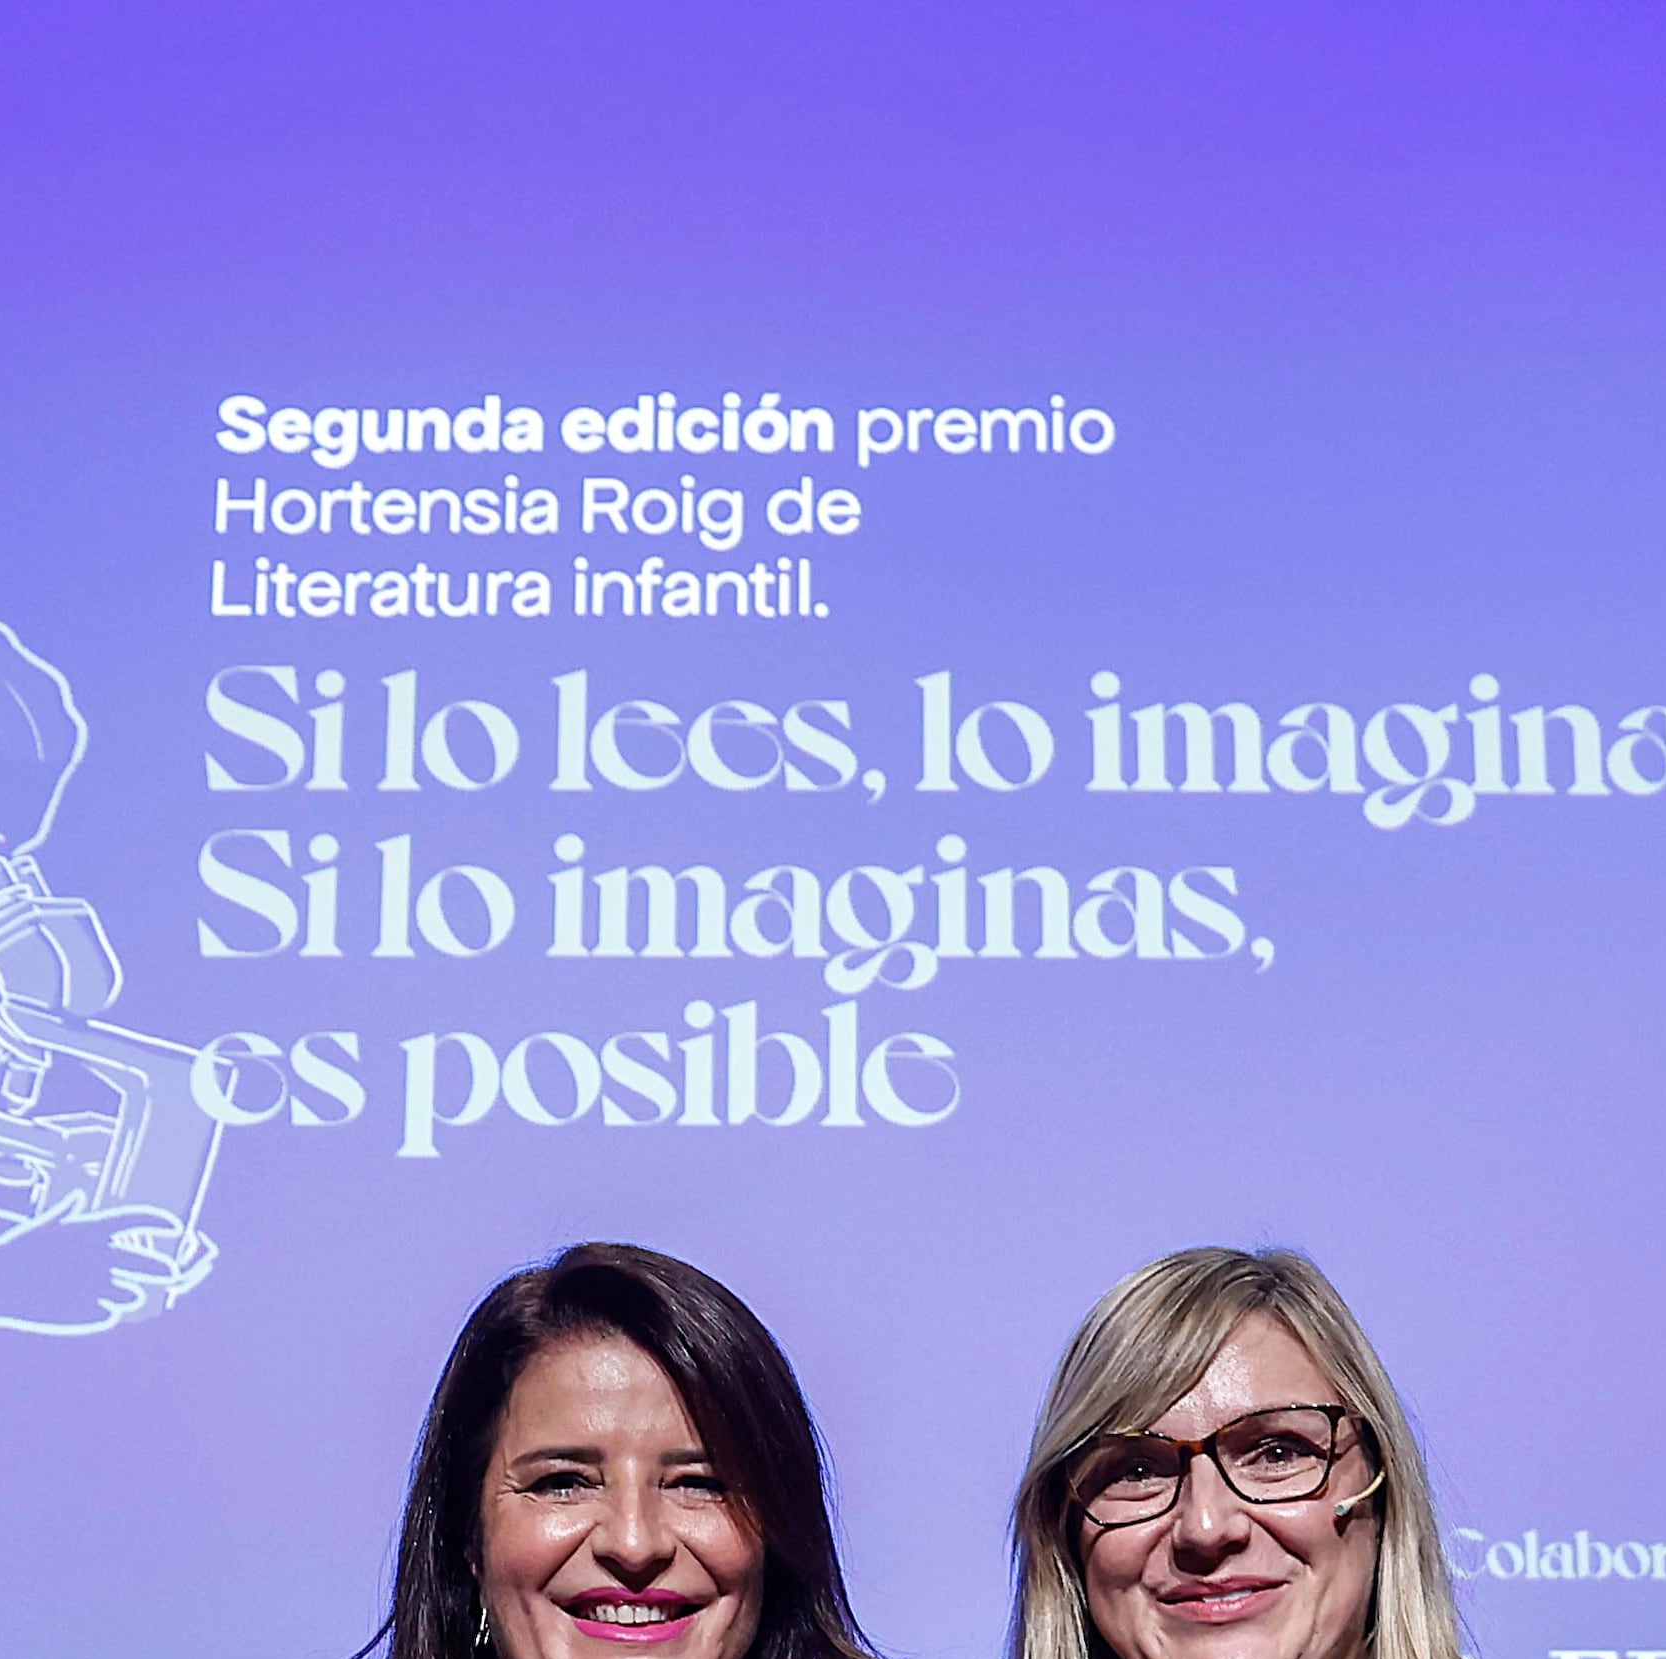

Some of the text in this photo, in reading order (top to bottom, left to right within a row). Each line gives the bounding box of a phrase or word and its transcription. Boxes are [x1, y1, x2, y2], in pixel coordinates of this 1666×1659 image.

[216, 391, 1115, 469] Segunda edición premio
[215, 474, 862, 551] Hortensia Roig de
[211, 556, 829, 618] Literatura infantil.
[205, 665, 349, 791] Si
[377, 669, 520, 791] lo
[549, 669, 886, 801] lees,
[915, 670, 1054, 792] lo
[197, 830, 1275, 995] Si lo imaginas,
[188, 999, 960, 1158] es posible
